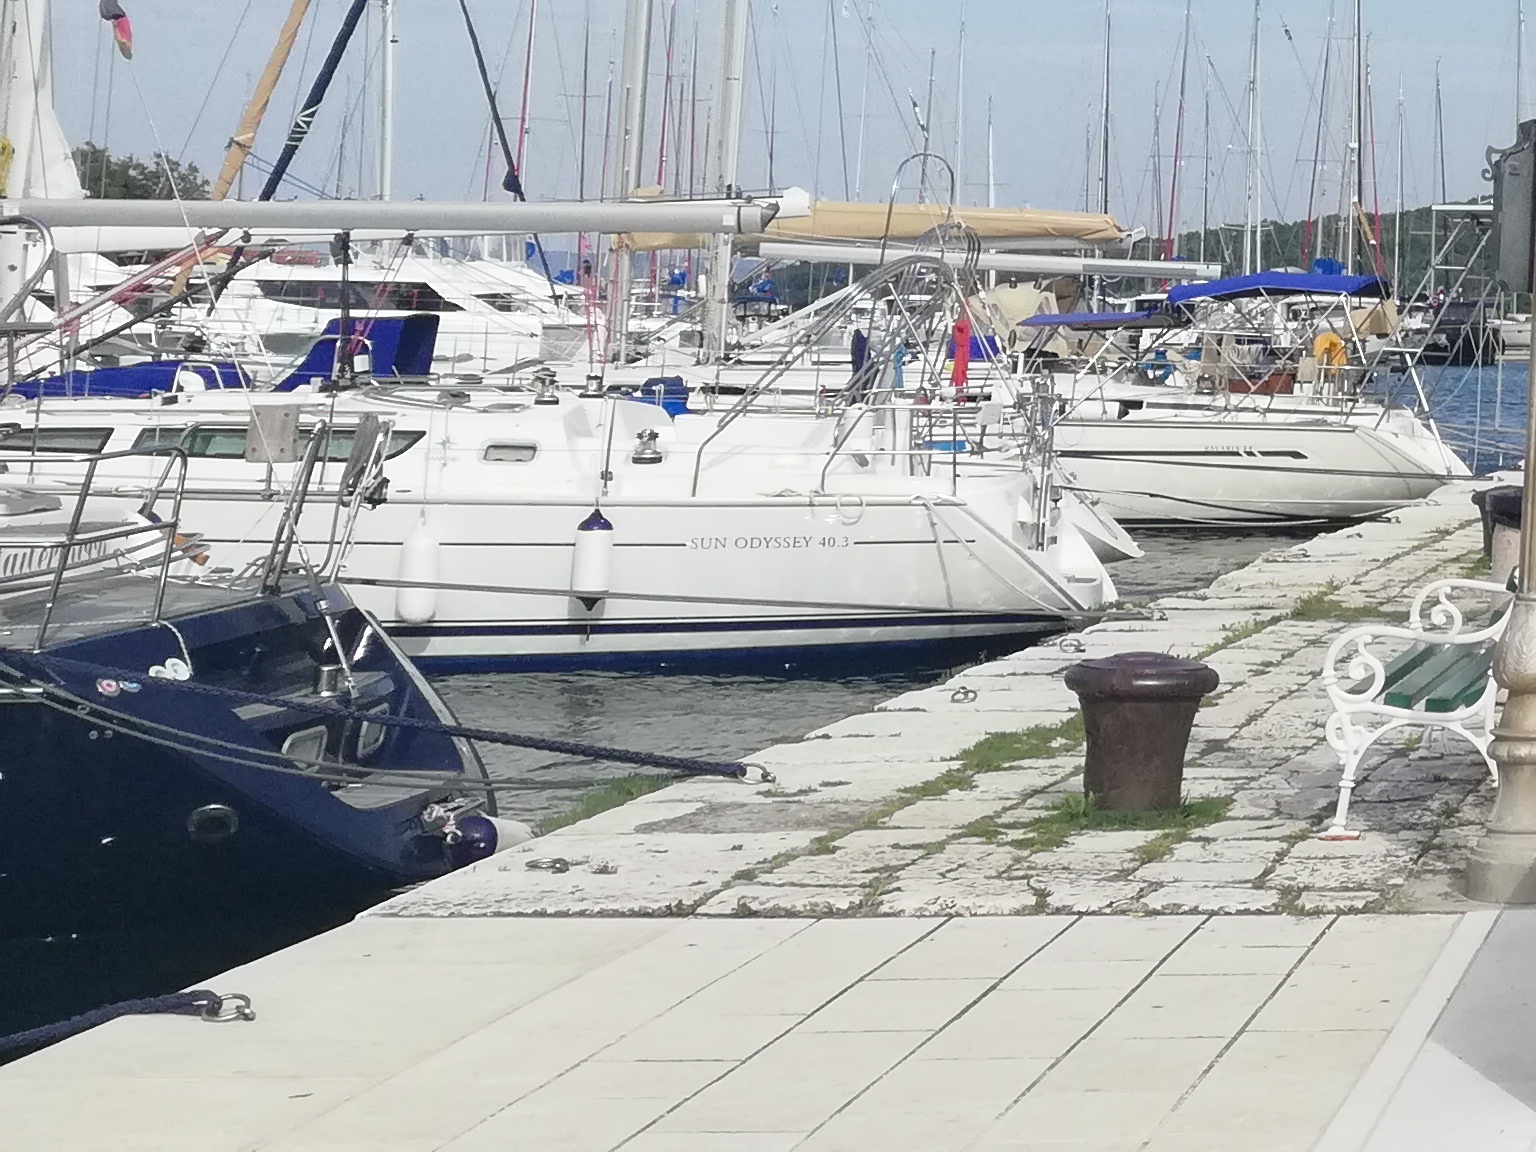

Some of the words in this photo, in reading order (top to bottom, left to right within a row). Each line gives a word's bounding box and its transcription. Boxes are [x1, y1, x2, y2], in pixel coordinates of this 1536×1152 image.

[690, 537, 727, 549] SUN
[734, 536, 813, 549] ODYSSEY
[818, 536, 850, 548] 40.3
